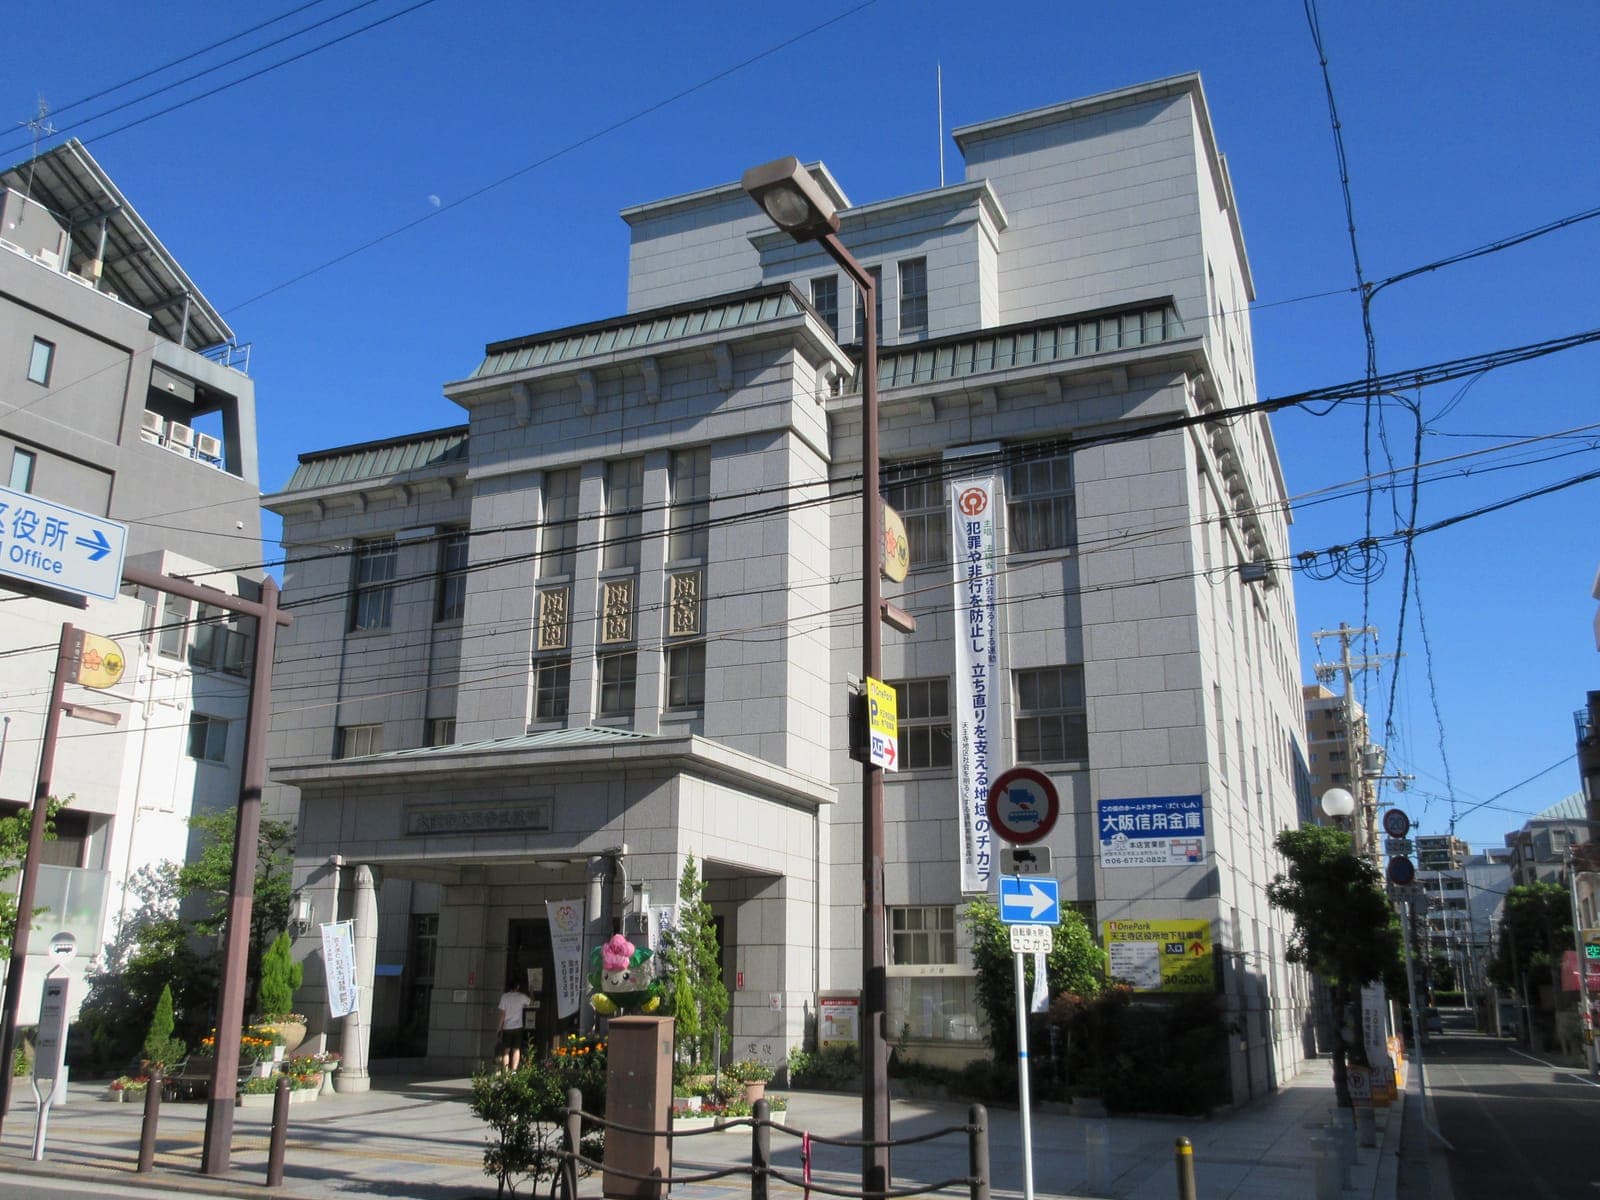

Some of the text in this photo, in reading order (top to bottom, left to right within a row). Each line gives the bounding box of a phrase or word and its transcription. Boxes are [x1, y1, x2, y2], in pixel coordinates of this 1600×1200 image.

[9, 544, 63, 574] Office
[966, 521, 990, 882] 犯罪や非行を防止し 立ち直りを支える地域のチカラ
[870, 699, 878, 725] P
[873, 740, 883, 755] 入口
[1102, 811, 1201, 832] 大阪信用金庫
[1117, 922, 1150, 930] OnePark
[1013, 938, 1050, 951] ここから
[1167, 944, 1183, 953] 入口
